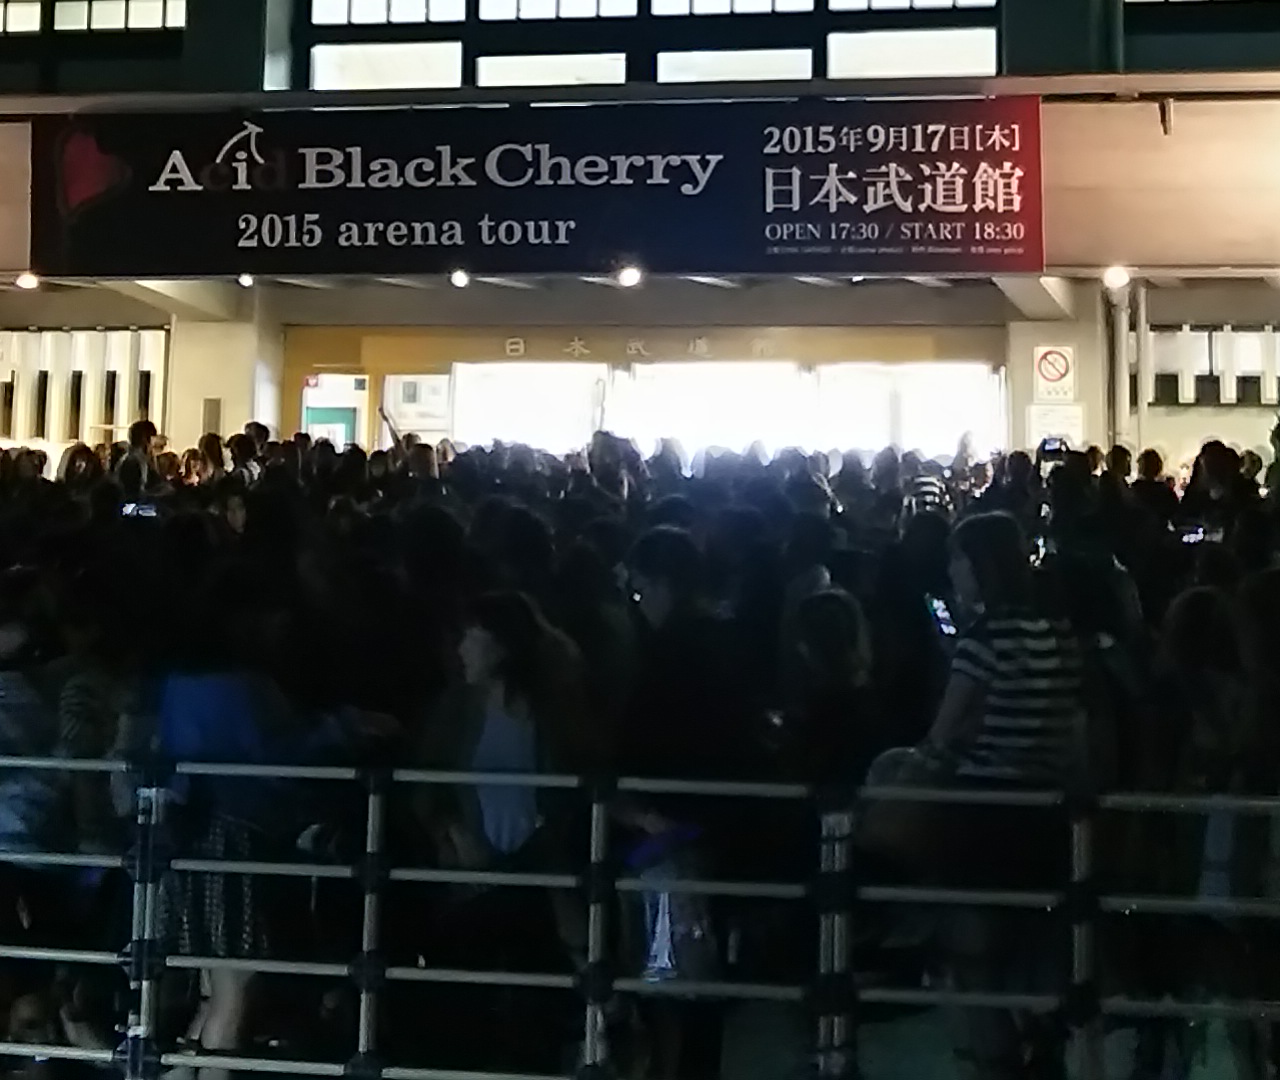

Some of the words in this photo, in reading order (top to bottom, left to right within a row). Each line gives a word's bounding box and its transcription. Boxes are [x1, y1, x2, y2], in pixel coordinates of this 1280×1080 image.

[298, 145, 477, 189] Black
[485, 143, 723, 195] Cherry
[765, 162, 1024, 213] 日本武道館
[237, 214, 322, 247] 2015
[338, 220, 464, 247] arena
[478, 214, 576, 245] tour
[764, 223, 821, 240] OPEN
[829, 223, 879, 240] 17:30
[900, 223, 965, 240] START
[974, 223, 1025, 240] 18:30
